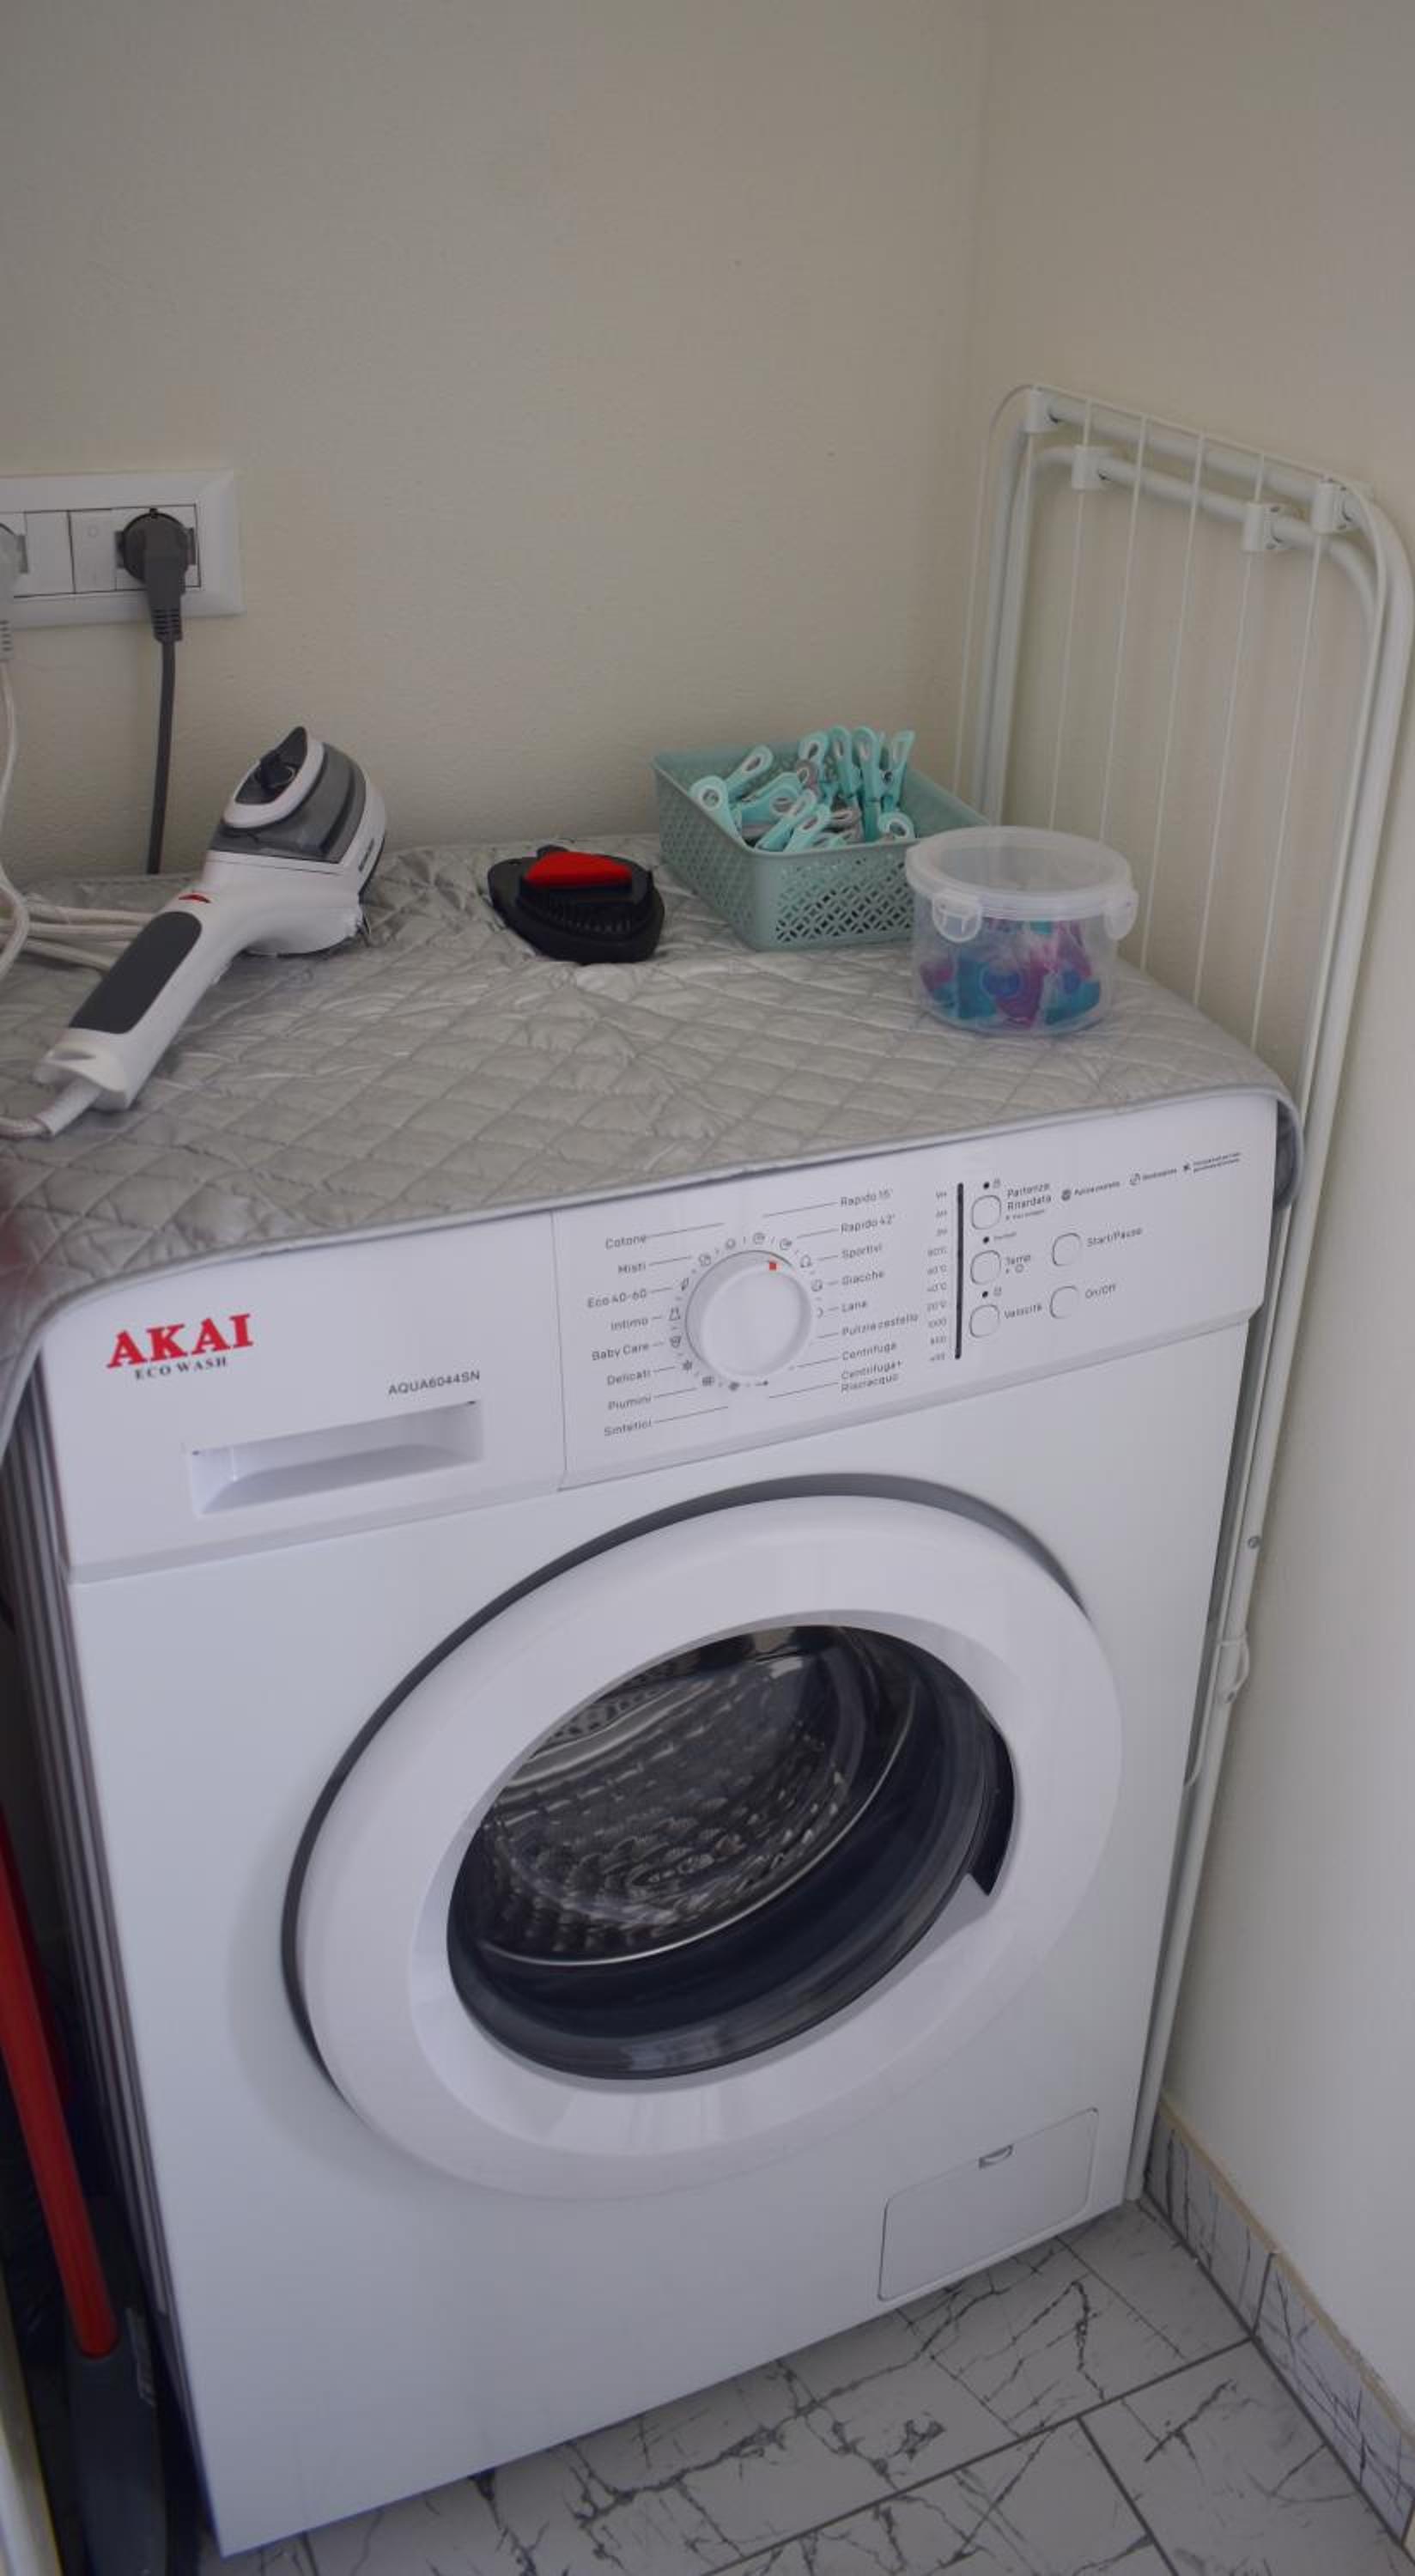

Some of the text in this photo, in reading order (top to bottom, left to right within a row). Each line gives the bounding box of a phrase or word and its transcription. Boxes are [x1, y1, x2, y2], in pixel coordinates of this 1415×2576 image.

[841, 1193, 877, 1206] Rapido
[841, 1219, 878, 1233] Rapido
[605, 1235, 647, 1249] Cotone
[841, 1242, 883, 1259] Sportivi
[618, 1263, 646, 1273] Misti
[841, 1271, 884, 1285] Giacche
[587, 1288, 647, 1308] Eco 40-60
[1084, 1284, 1116, 1299] On/Off
[841, 1301, 867, 1312] Lana
[611, 1317, 648, 1330] Intimo
[106, 1312, 255, 1369] AKAI
[592, 1344, 649, 1361] Baby Care
[842, 1342, 896, 1360] Centrifuga
[135, 1357, 228, 1381] ECO WASH
[388, 1370, 480, 1396] AQUA6044SN
[607, 1370, 651, 1385] Delicati
[608, 1394, 651, 1410] Piumini
[604, 1419, 651, 1437] Sintetici
